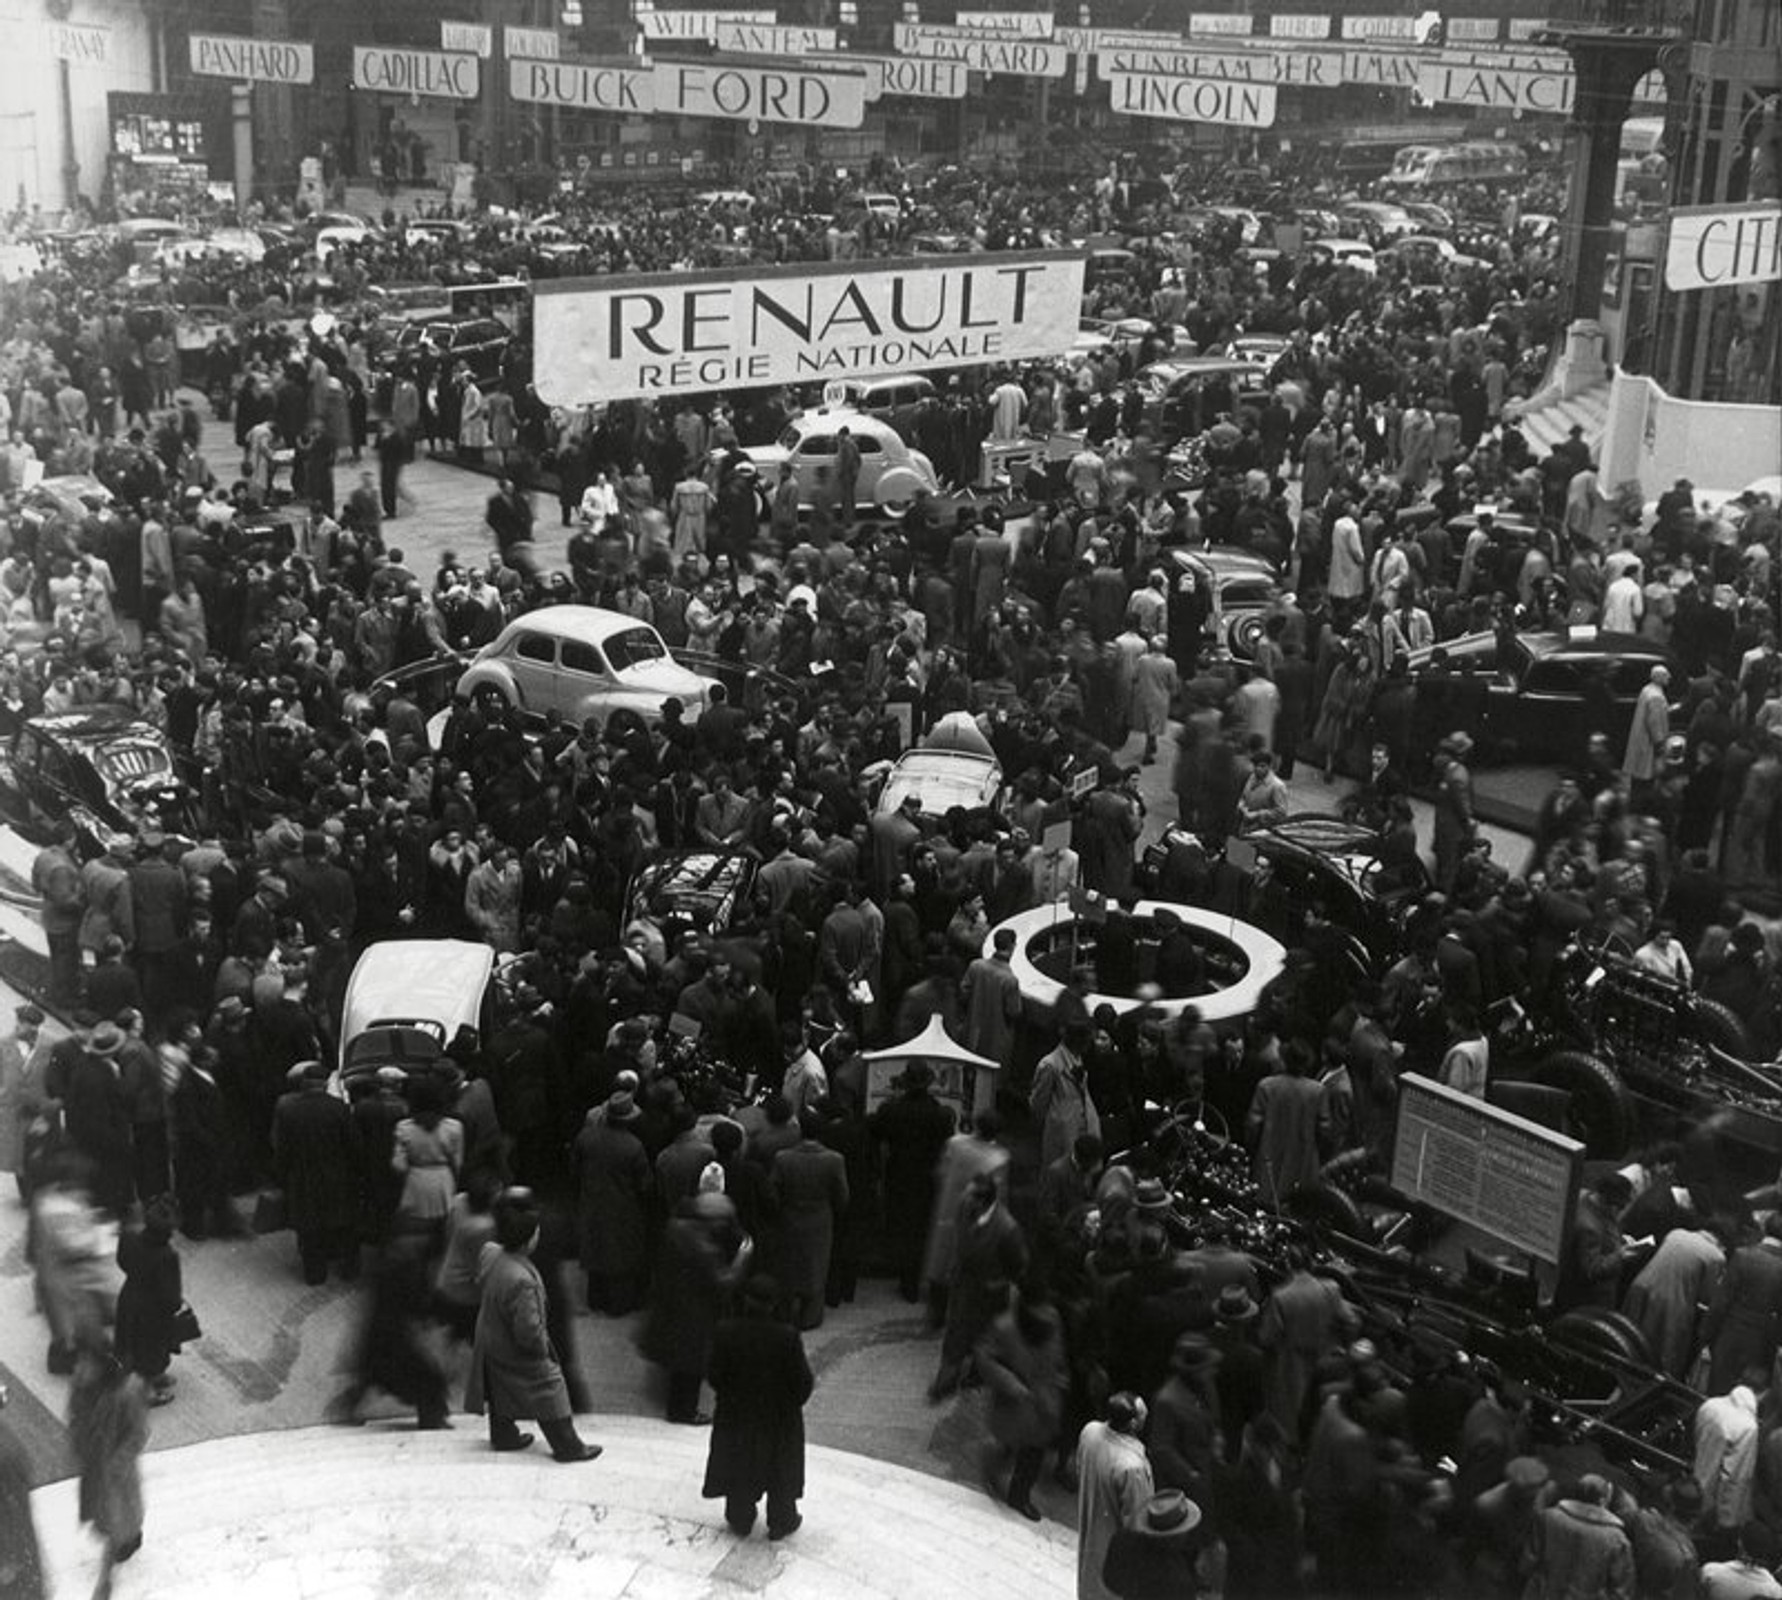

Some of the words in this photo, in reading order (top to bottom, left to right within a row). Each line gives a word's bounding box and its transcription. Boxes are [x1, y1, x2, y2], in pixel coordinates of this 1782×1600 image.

[199, 40, 299, 79] PANHARD
[730, 28, 819, 49] ANTEM
[933, 40, 1048, 72] PACKARD
[362, 51, 469, 95] CADILLAC
[530, 65, 638, 108] BUICK
[1113, 54, 1251, 78] SUNBEAM
[679, 69, 830, 120] FORD
[1124, 77, 1262, 121] LINCOLN
[1697, 217, 1782, 283] CIT
[609, 266, 1046, 359] RENAULT
[639, 355, 770, 388] RÉGIE
[797, 332, 1002, 372] NATIONALE
